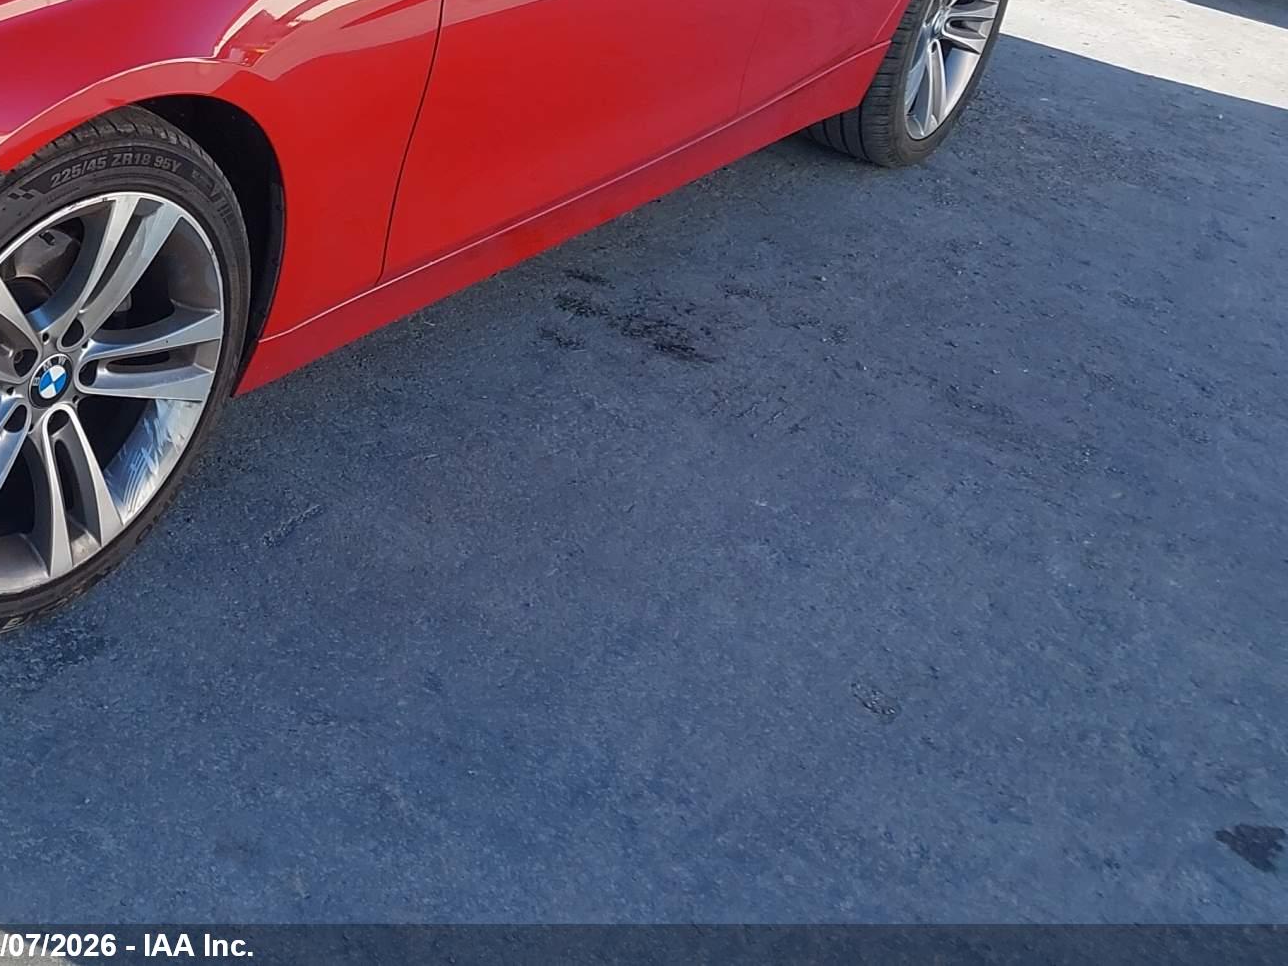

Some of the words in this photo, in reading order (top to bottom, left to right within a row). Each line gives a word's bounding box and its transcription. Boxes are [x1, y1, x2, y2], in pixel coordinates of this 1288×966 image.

[51, 156, 108, 188] 225/45
[112, 153, 151, 167] ZR18
[153, 155, 182, 173] 95Y
